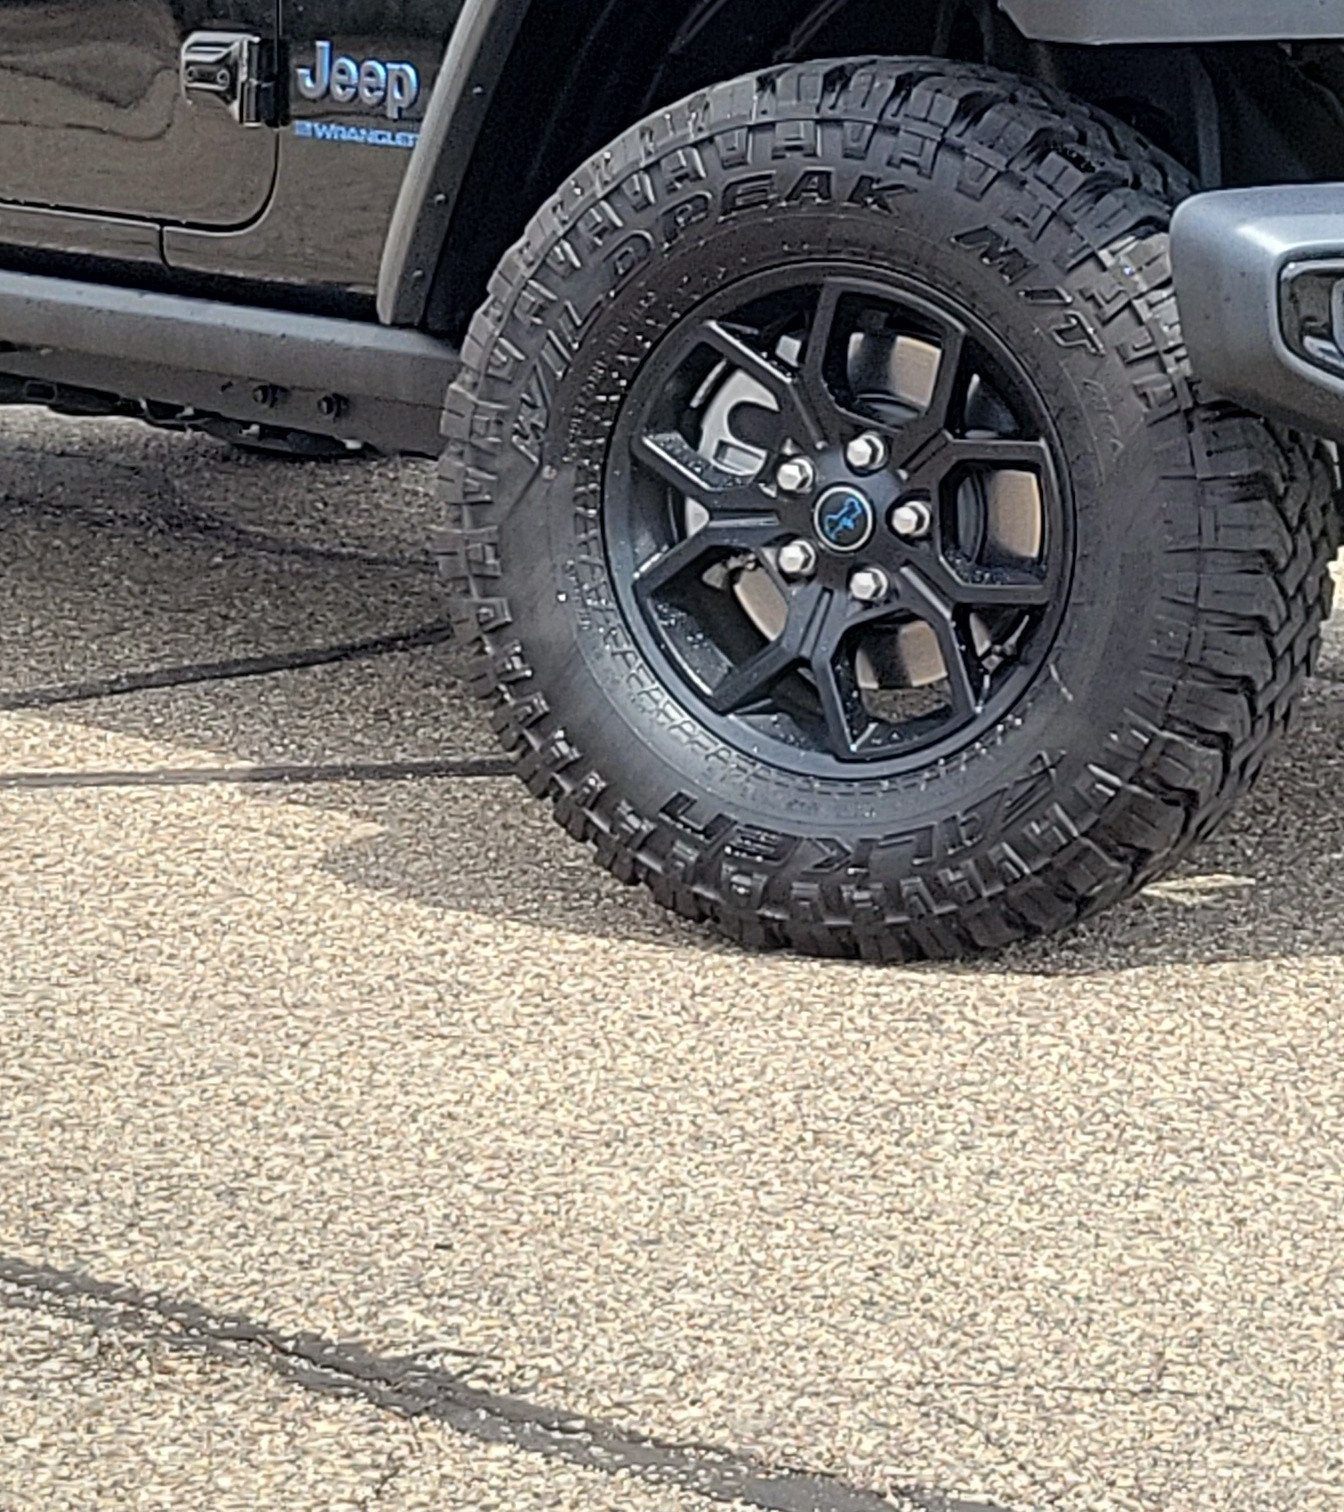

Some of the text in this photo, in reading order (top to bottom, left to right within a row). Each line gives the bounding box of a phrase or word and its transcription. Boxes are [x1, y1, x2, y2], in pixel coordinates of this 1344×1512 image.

[296, 40, 418, 119] Jeep
[313, 121, 420, 148] WRANGLE
[511, 168, 919, 465] WILDPEAK
